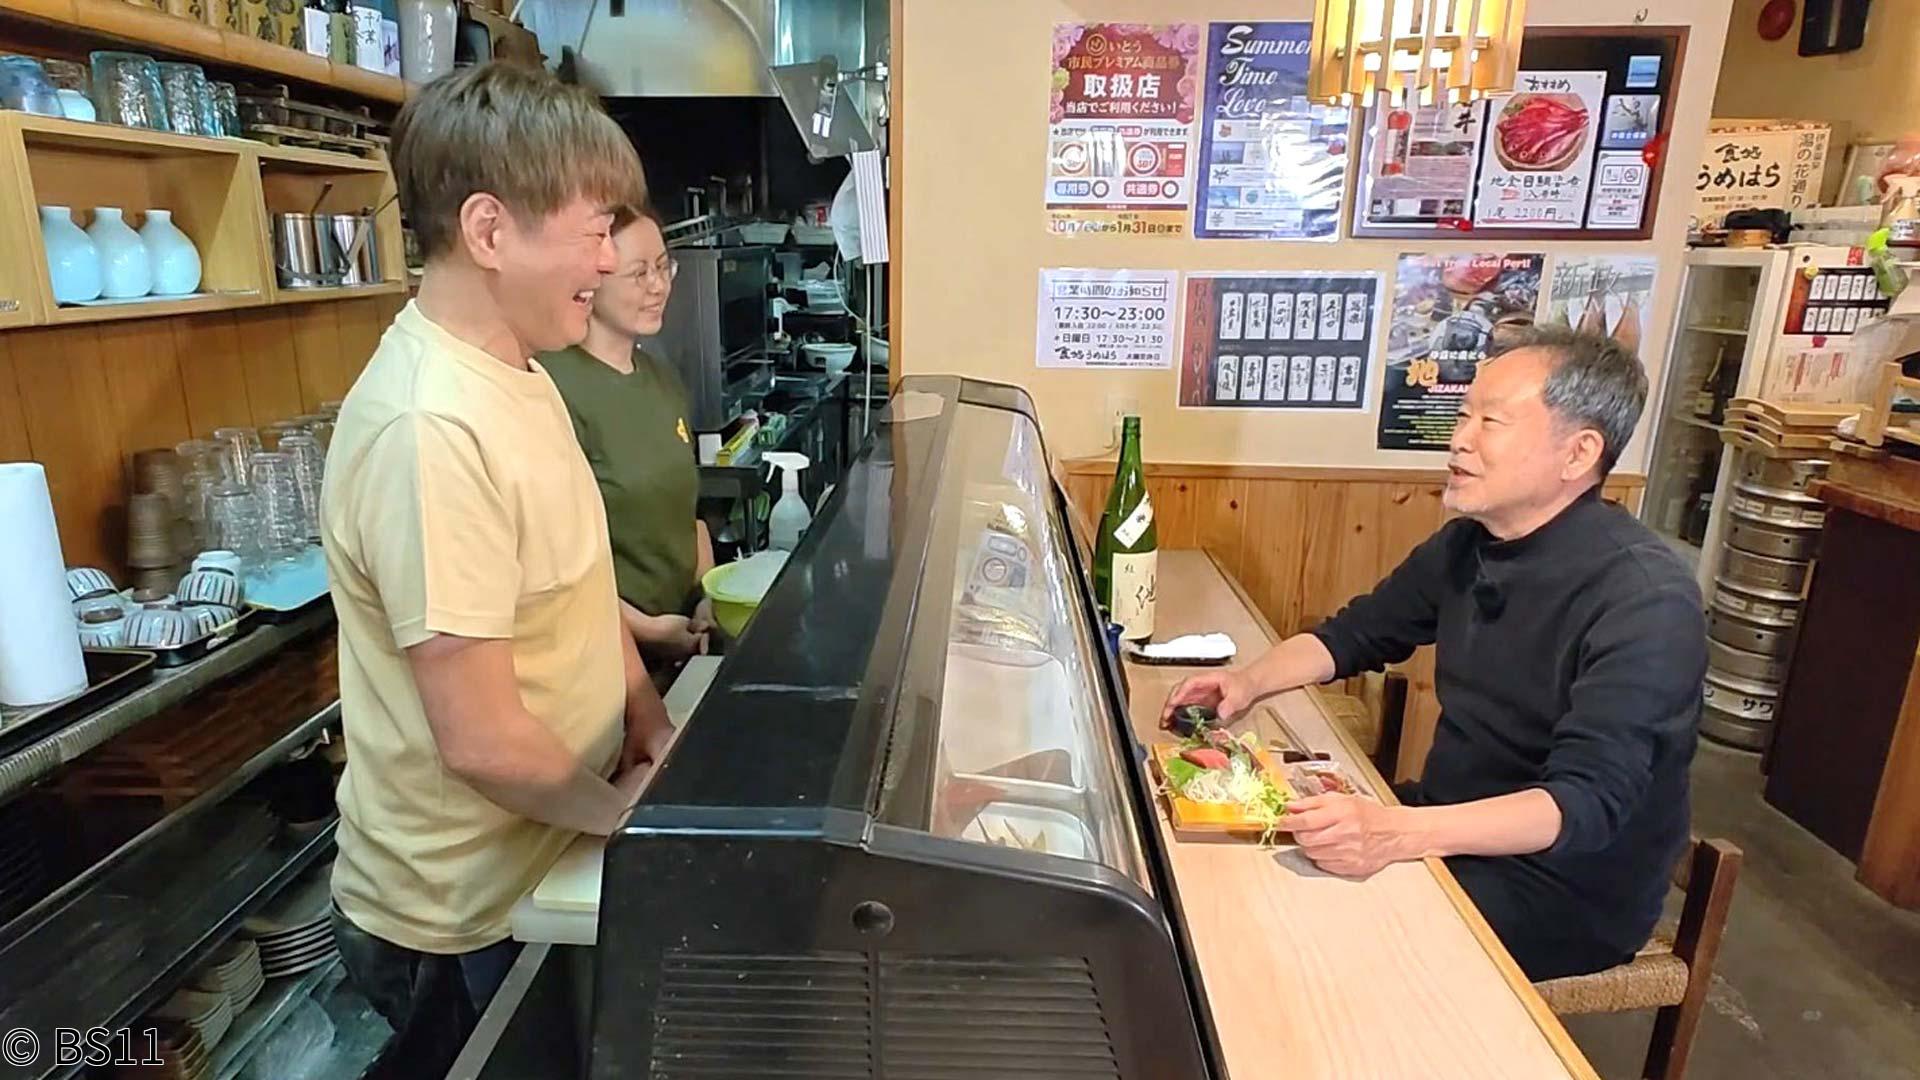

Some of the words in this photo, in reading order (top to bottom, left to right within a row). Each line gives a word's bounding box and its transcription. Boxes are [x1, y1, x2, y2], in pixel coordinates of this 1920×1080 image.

[1109, 41, 1142, 52] いとう
[1219, 58, 1279, 86] Time
[1084, 74, 1162, 98] 取扱店
[1524, 75, 1572, 92] おすすめ
[1216, 87, 1266, 117] Love
[1714, 142, 1762, 163] 食処
[1696, 163, 1781, 190] うめはら
[1472, 258, 1500, 268] Local
